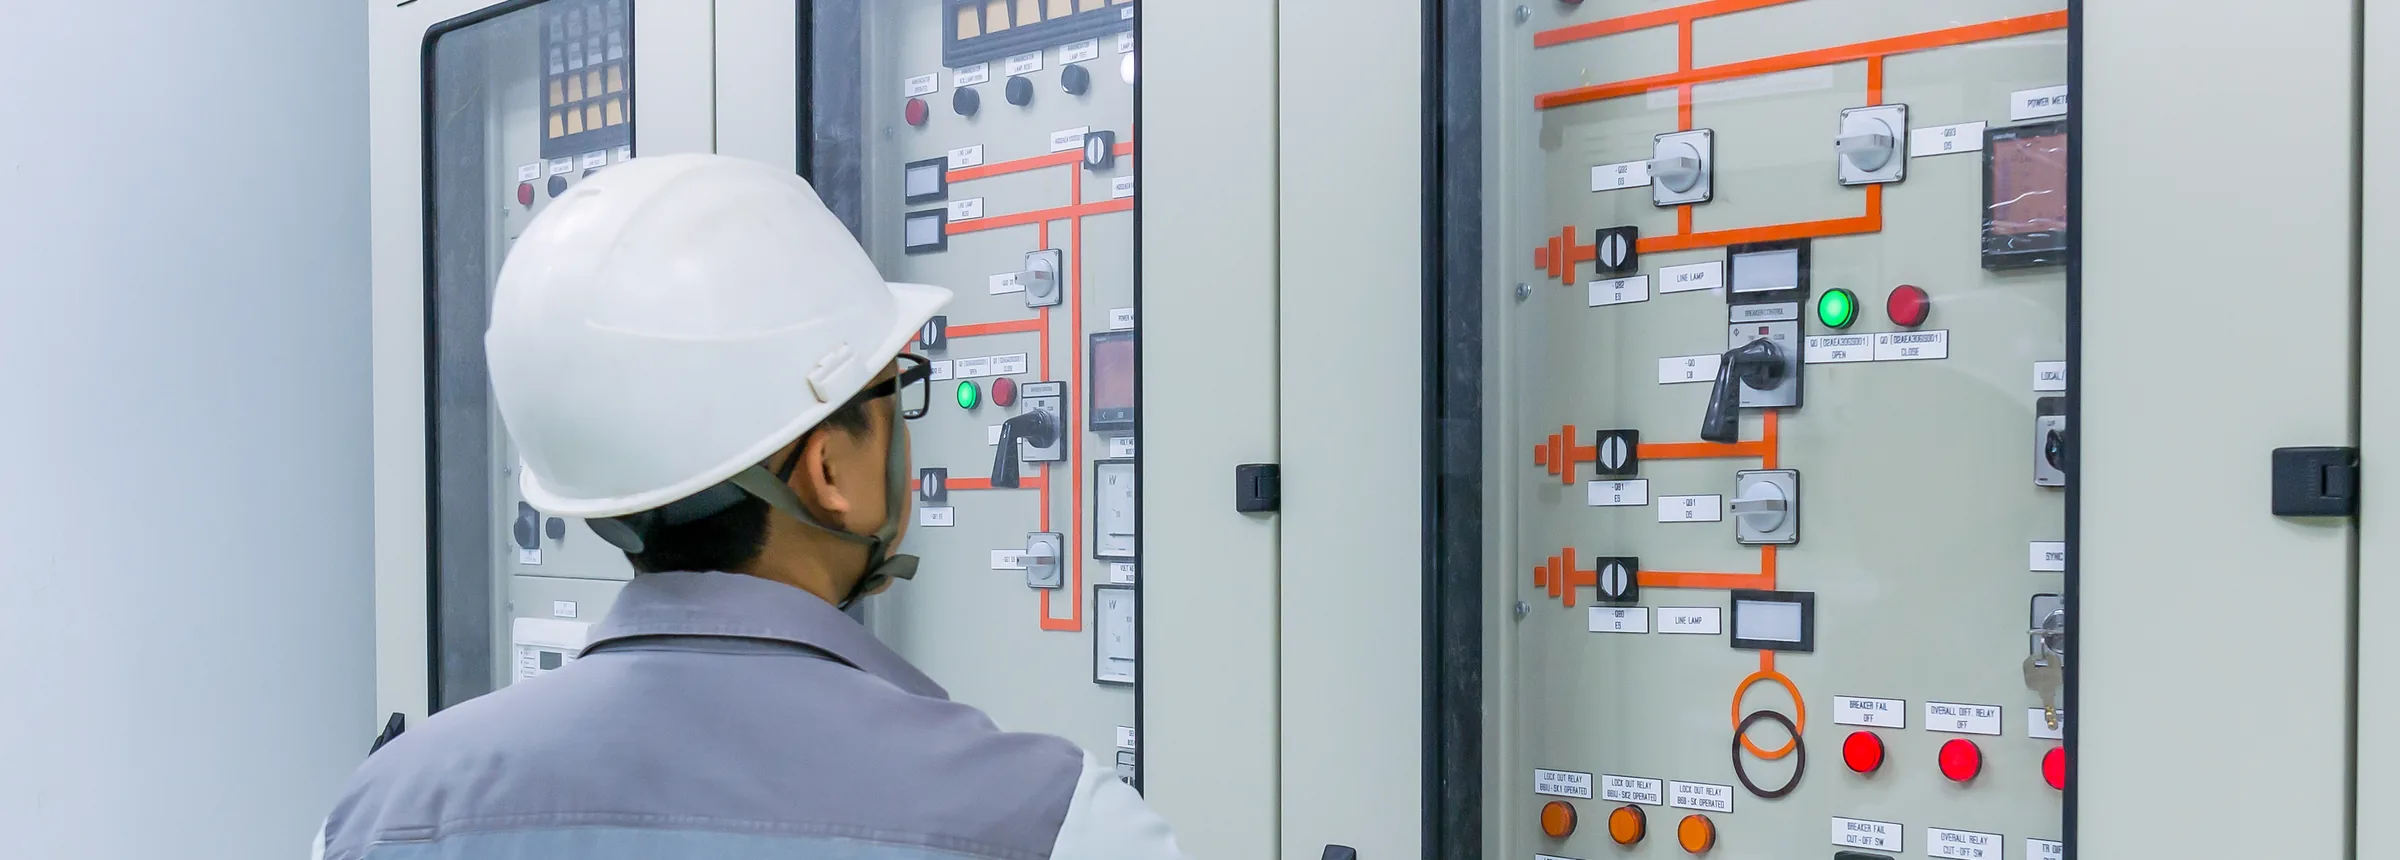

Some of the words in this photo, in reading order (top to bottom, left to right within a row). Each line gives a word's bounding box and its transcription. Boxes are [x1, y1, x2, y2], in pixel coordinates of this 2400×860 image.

[2027, 97, 2049, 108] POWER
[1677, 273, 1688, 283] LINE
[1690, 272, 1704, 282] LAMP
[1832, 351, 1846, 359] OPEN
[1901, 347, 1919, 356] CLOSE
[1675, 617, 1686, 625] LINE
[1688, 617, 1702, 625] LAMP
[1850, 700, 1874, 710] BREAKER
[1876, 702, 1888, 711] FAIL
[1931, 706, 1956, 716] OVERALL
[1976, 708, 1995, 718] RELAY
[1863, 714, 1874, 723] OFF
[1957, 720, 1968, 729] OFF
[1544, 772, 1556, 782] LOCK
[1557, 773, 1566, 783] OUT
[1568, 774, 1582, 784] RELAY
[1611, 778, 1623, 787] LOCK
[1626, 779, 1635, 788] OUT
[1636, 780, 1652, 790] RELAY
[1564, 785, 1587, 796] OPERATED
[1679, 785, 1692, 794] LOCK
[1694, 786, 1704, 795] OUT
[1706, 787, 1722, 797] RELAY
[1633, 791, 1657, 802] OPERATED
[1699, 798, 1725, 809] OPERATED
[1847, 822, 1872, 833] BREAKER
[1873, 824, 1886, 835] FAIL
[1875, 838, 1884, 847] SW
[1941, 832, 1966, 844] OVERALL
[1969, 835, 1988, 845] RELAY
[1972, 848, 1983, 858] SW
